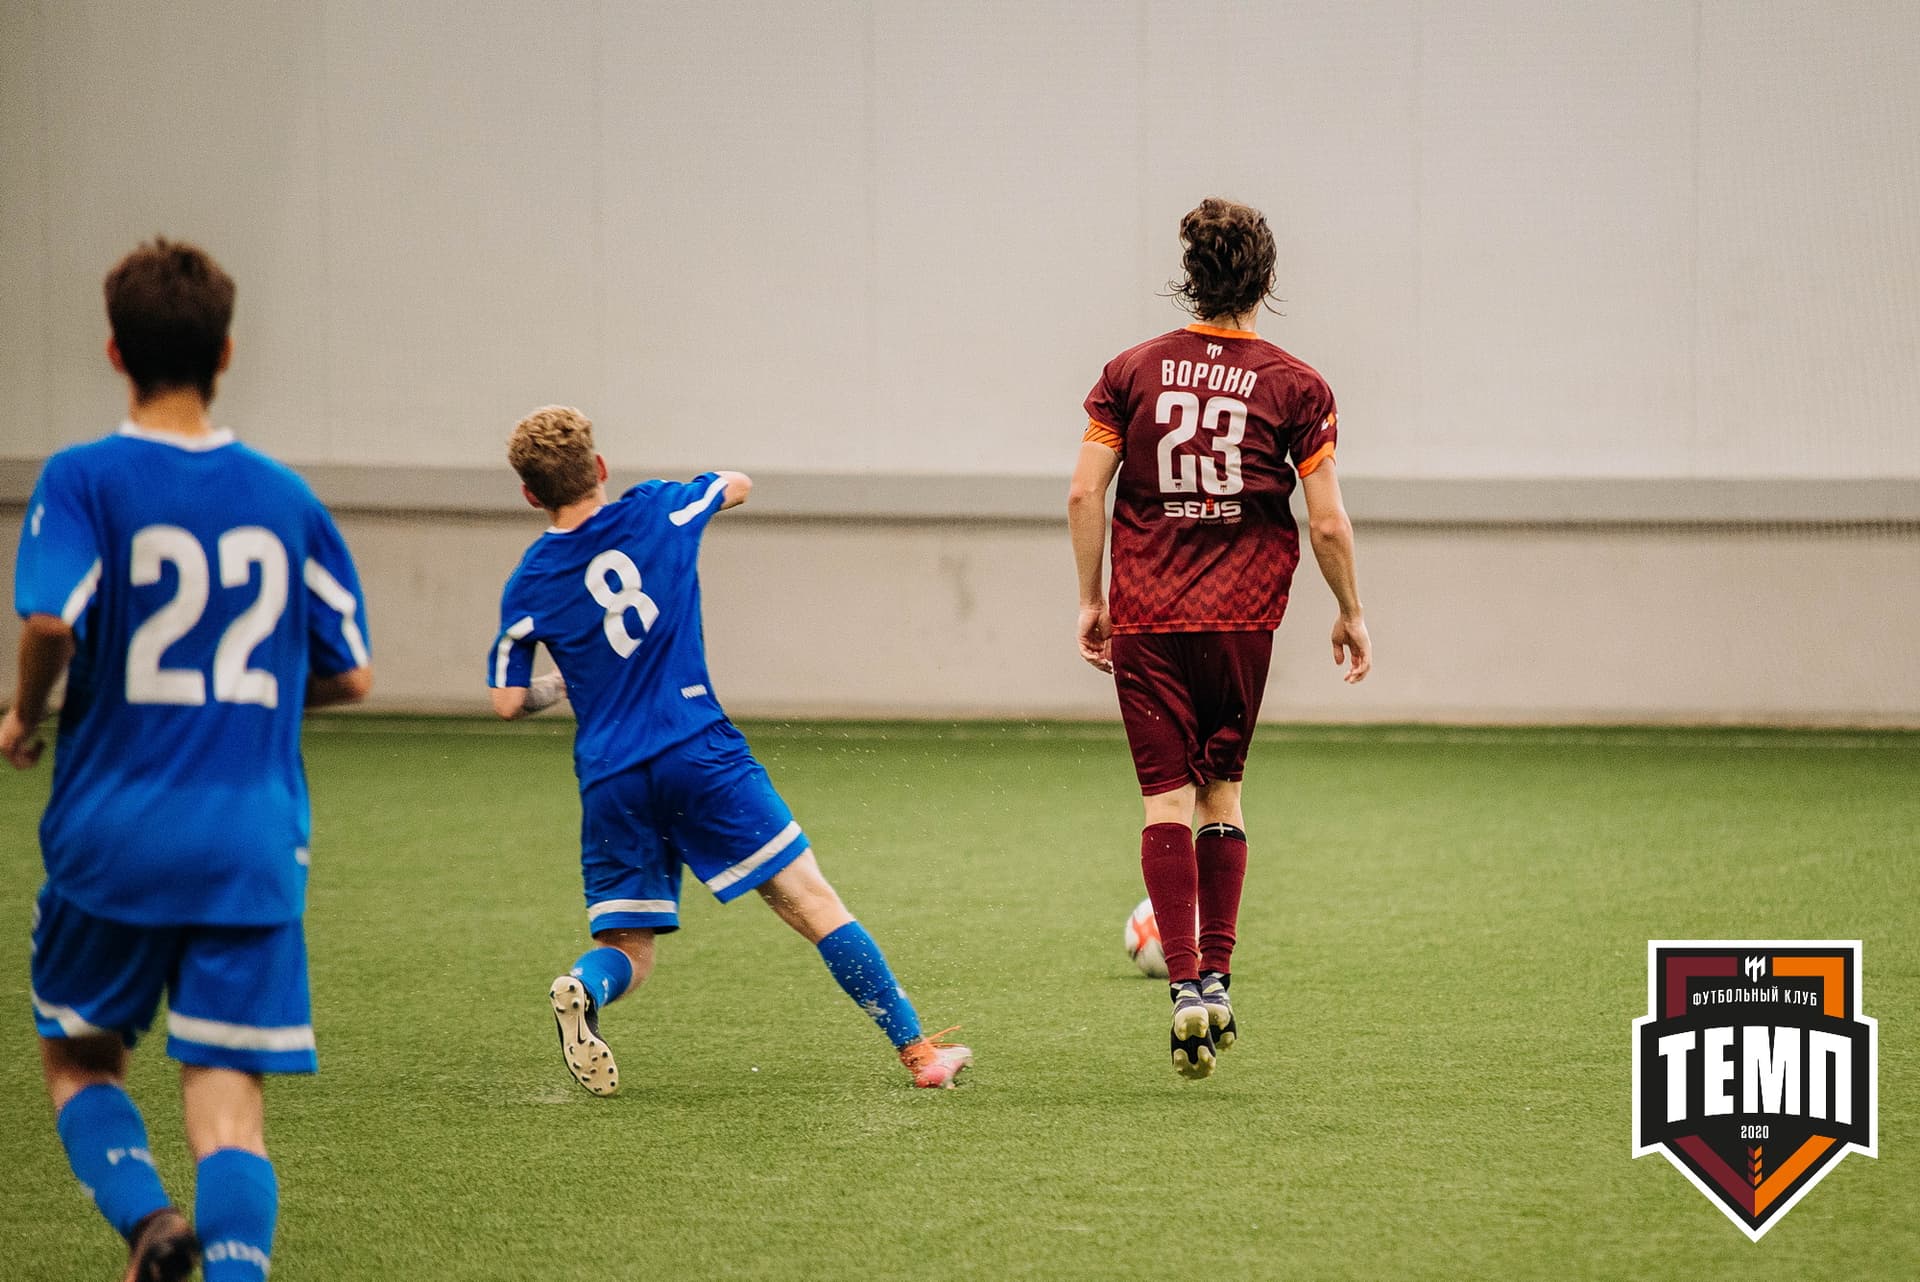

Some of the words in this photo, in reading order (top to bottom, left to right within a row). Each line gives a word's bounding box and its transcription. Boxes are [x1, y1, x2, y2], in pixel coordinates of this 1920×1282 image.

[1161, 359, 1258, 398] ВОРОНА
[1155, 390, 1248, 495] 23
[1163, 500, 1242, 519] SEUS
[125, 524, 289, 709] 22
[584, 549, 660, 660] 8
